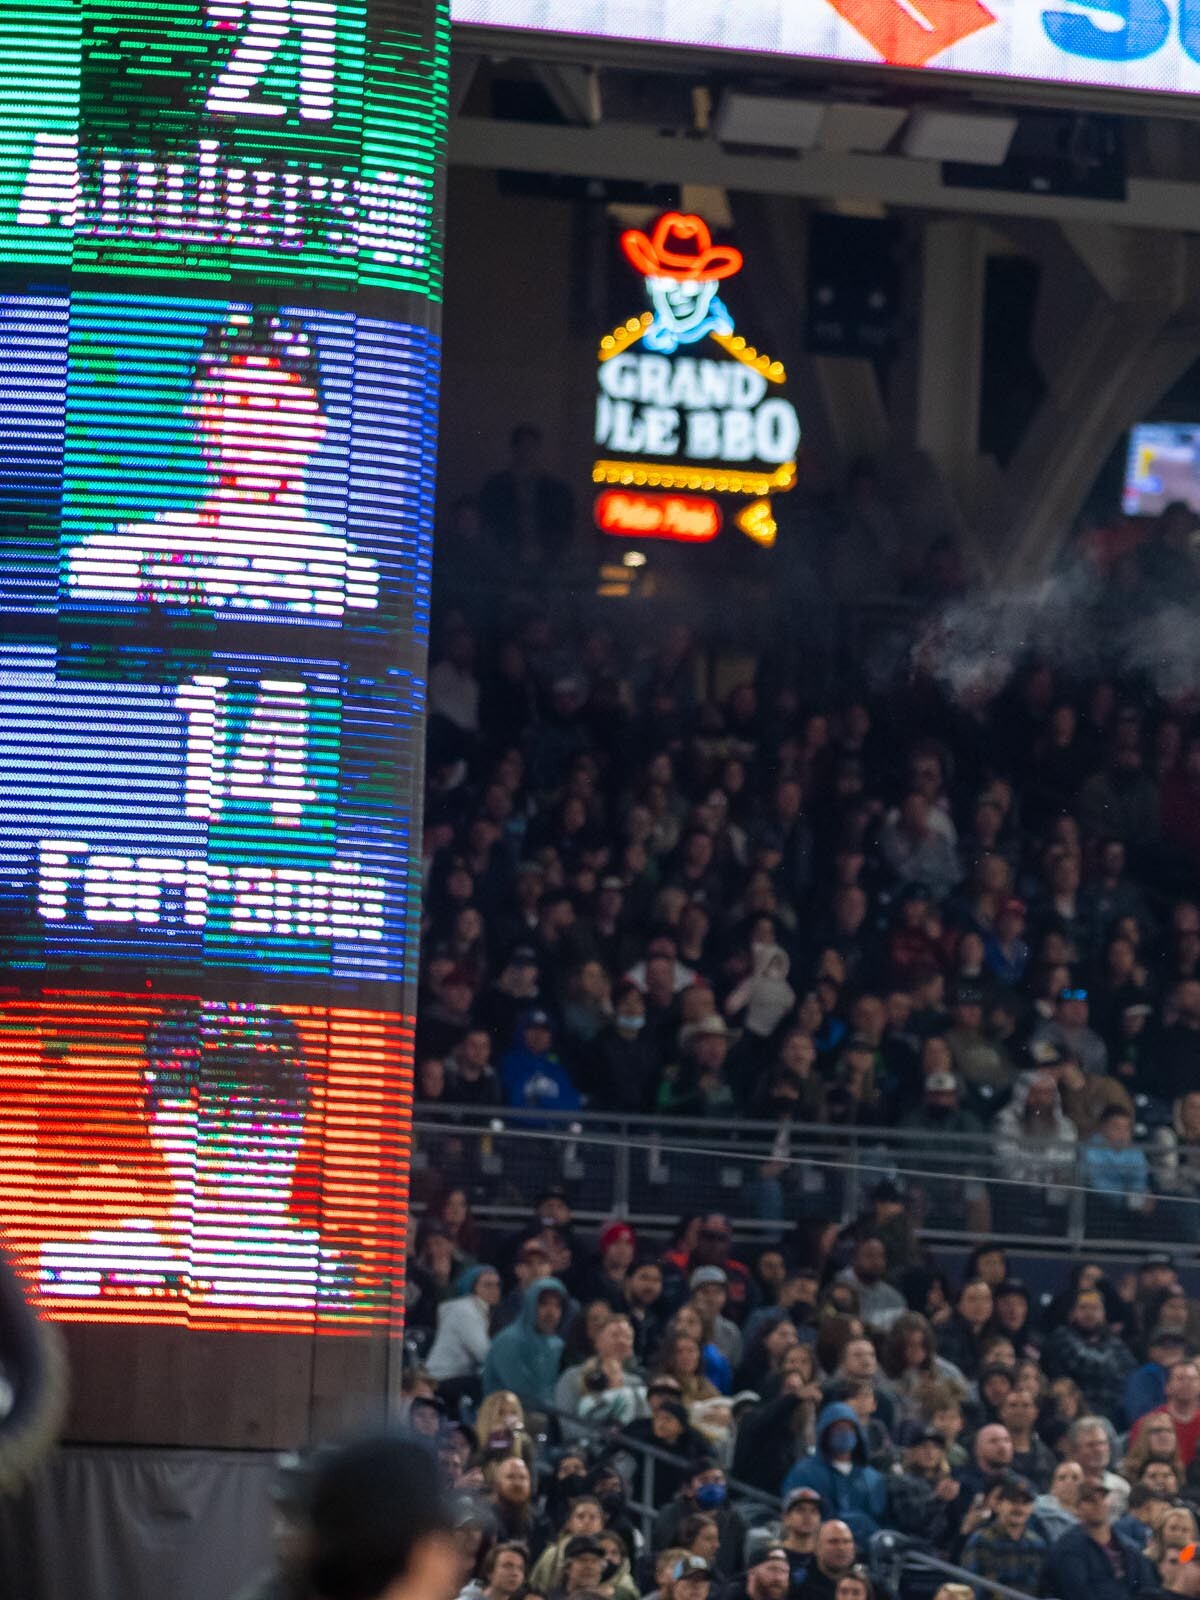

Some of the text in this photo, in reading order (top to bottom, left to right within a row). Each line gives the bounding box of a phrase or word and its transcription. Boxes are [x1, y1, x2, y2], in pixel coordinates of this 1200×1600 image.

[204, 0, 336, 119] 21
[598, 352, 768, 409] GRAND
[173, 676, 319, 822] 14
